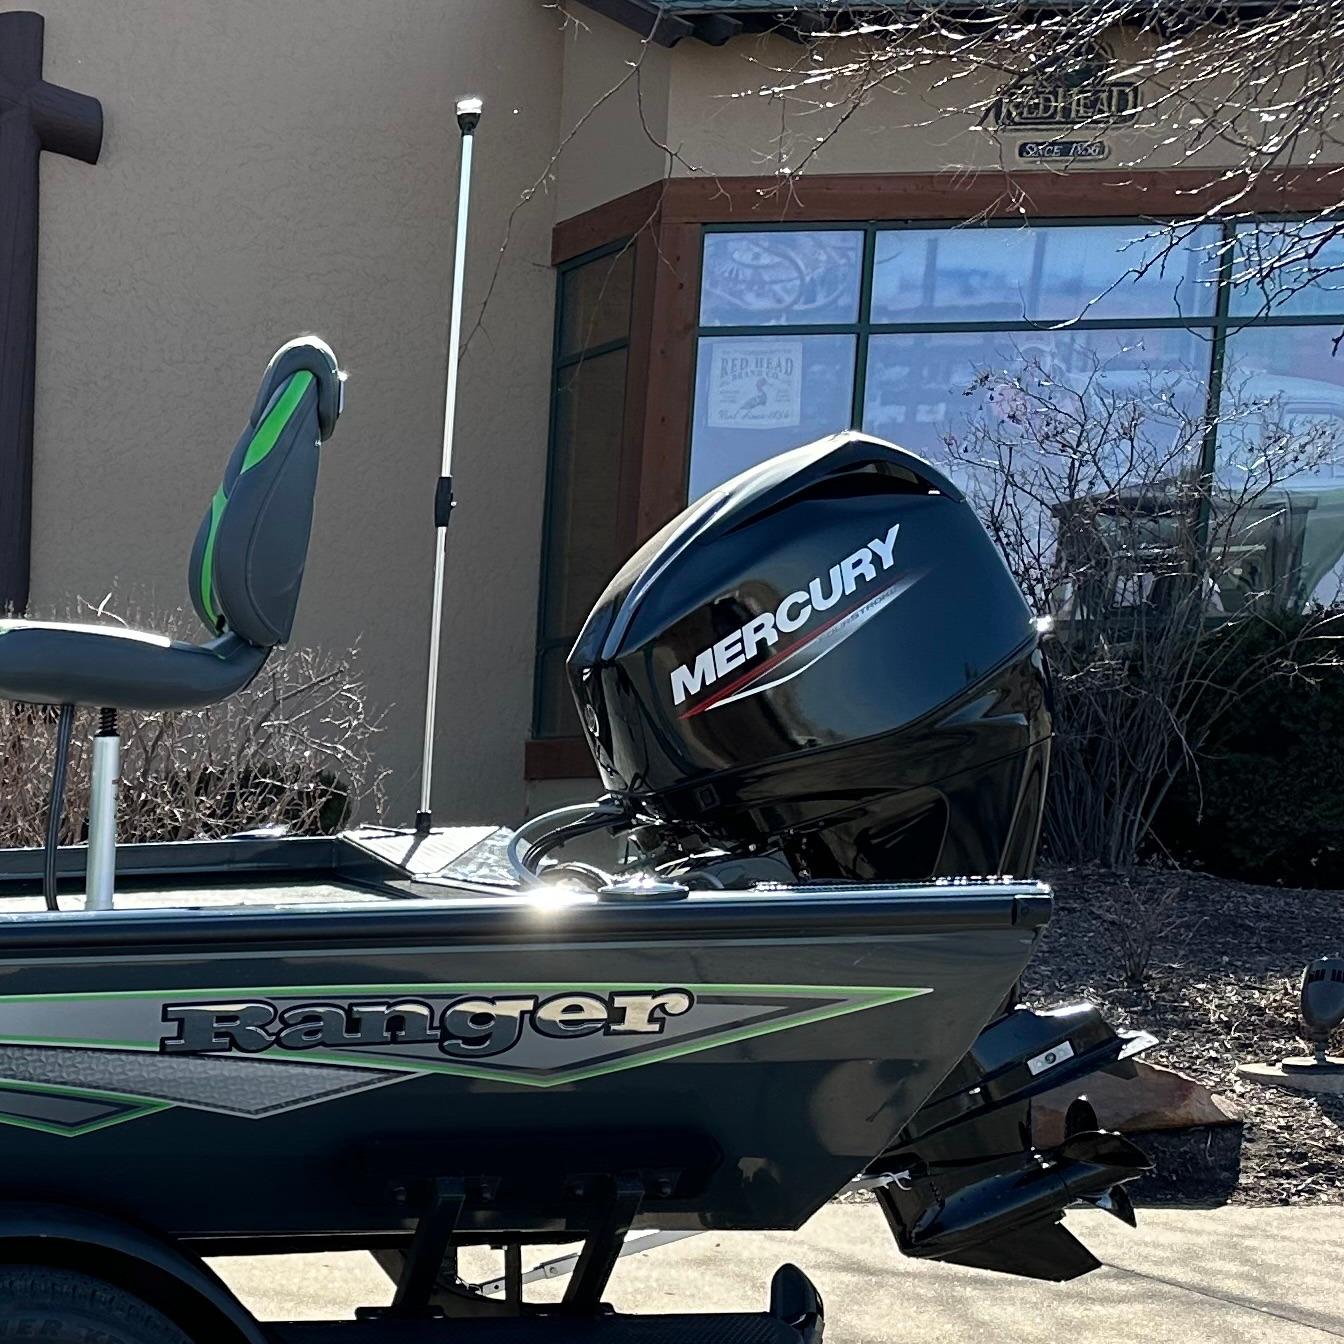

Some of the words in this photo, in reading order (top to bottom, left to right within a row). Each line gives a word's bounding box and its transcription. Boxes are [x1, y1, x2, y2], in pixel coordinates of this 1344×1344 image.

[720, 357, 749, 378] RED
[755, 356, 794, 377] HEAD
[670, 523, 900, 706] MERCURY
[162, 989, 693, 1056] Ranger
